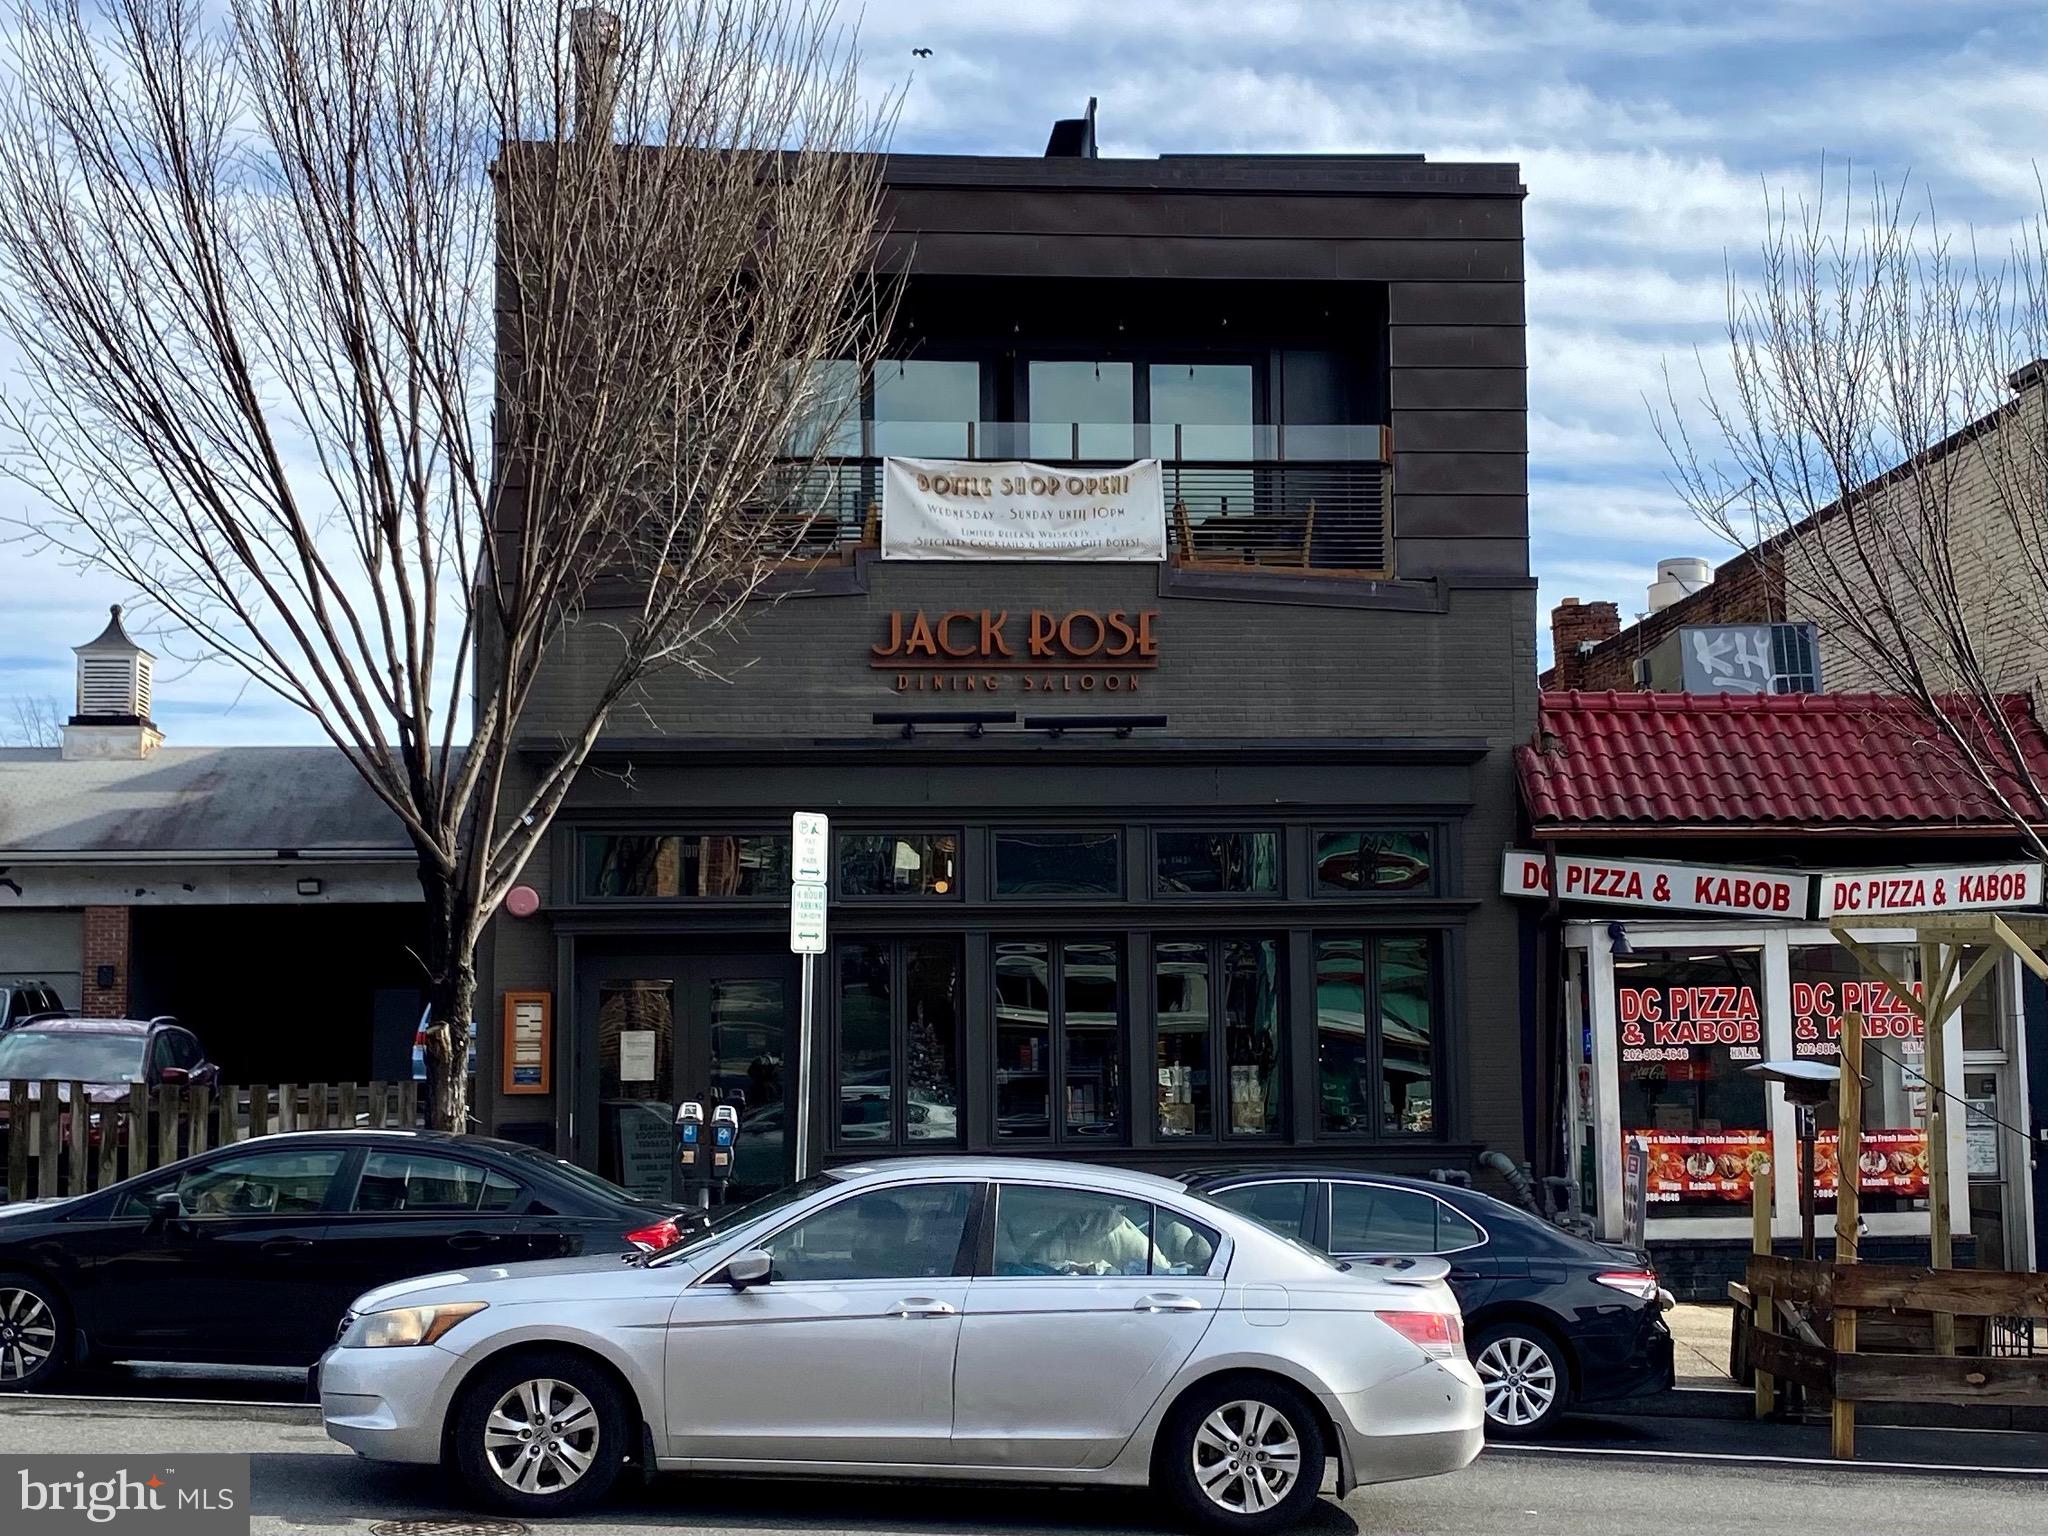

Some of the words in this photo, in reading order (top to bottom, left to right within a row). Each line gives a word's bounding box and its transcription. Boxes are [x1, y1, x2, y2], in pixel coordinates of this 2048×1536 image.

[916, 473, 993, 498] BOTTLE
[1000, 475, 1061, 497] SHOP
[1065, 474, 1129, 496] OPEN!
[871, 609, 1014, 656] JACK
[1028, 609, 1160, 656] ROSE
[897, 674, 999, 690] DINING
[1023, 674, 1140, 690] SALOON
[1566, 865, 1644, 899] PIZZA
[1652, 874, 1672, 902] &
[1695, 876, 1791, 912] KABOB
[1834, 882, 1862, 911] DC
[1868, 880, 1926, 909] PIZZA
[1933, 878, 1947, 906] &
[1959, 873, 2027, 903] KABOB
[1620, 988, 1662, 1022] DC
[1669, 987, 1760, 1021] PIZZA
[1793, 982, 1835, 1017] DC
[1622, 1022, 1645, 1045] &
[1654, 1020, 1760, 1044] KABOB
[1796, 1016, 1819, 1039] &
[1623, 1048, 1689, 1061] 202-986-4646
